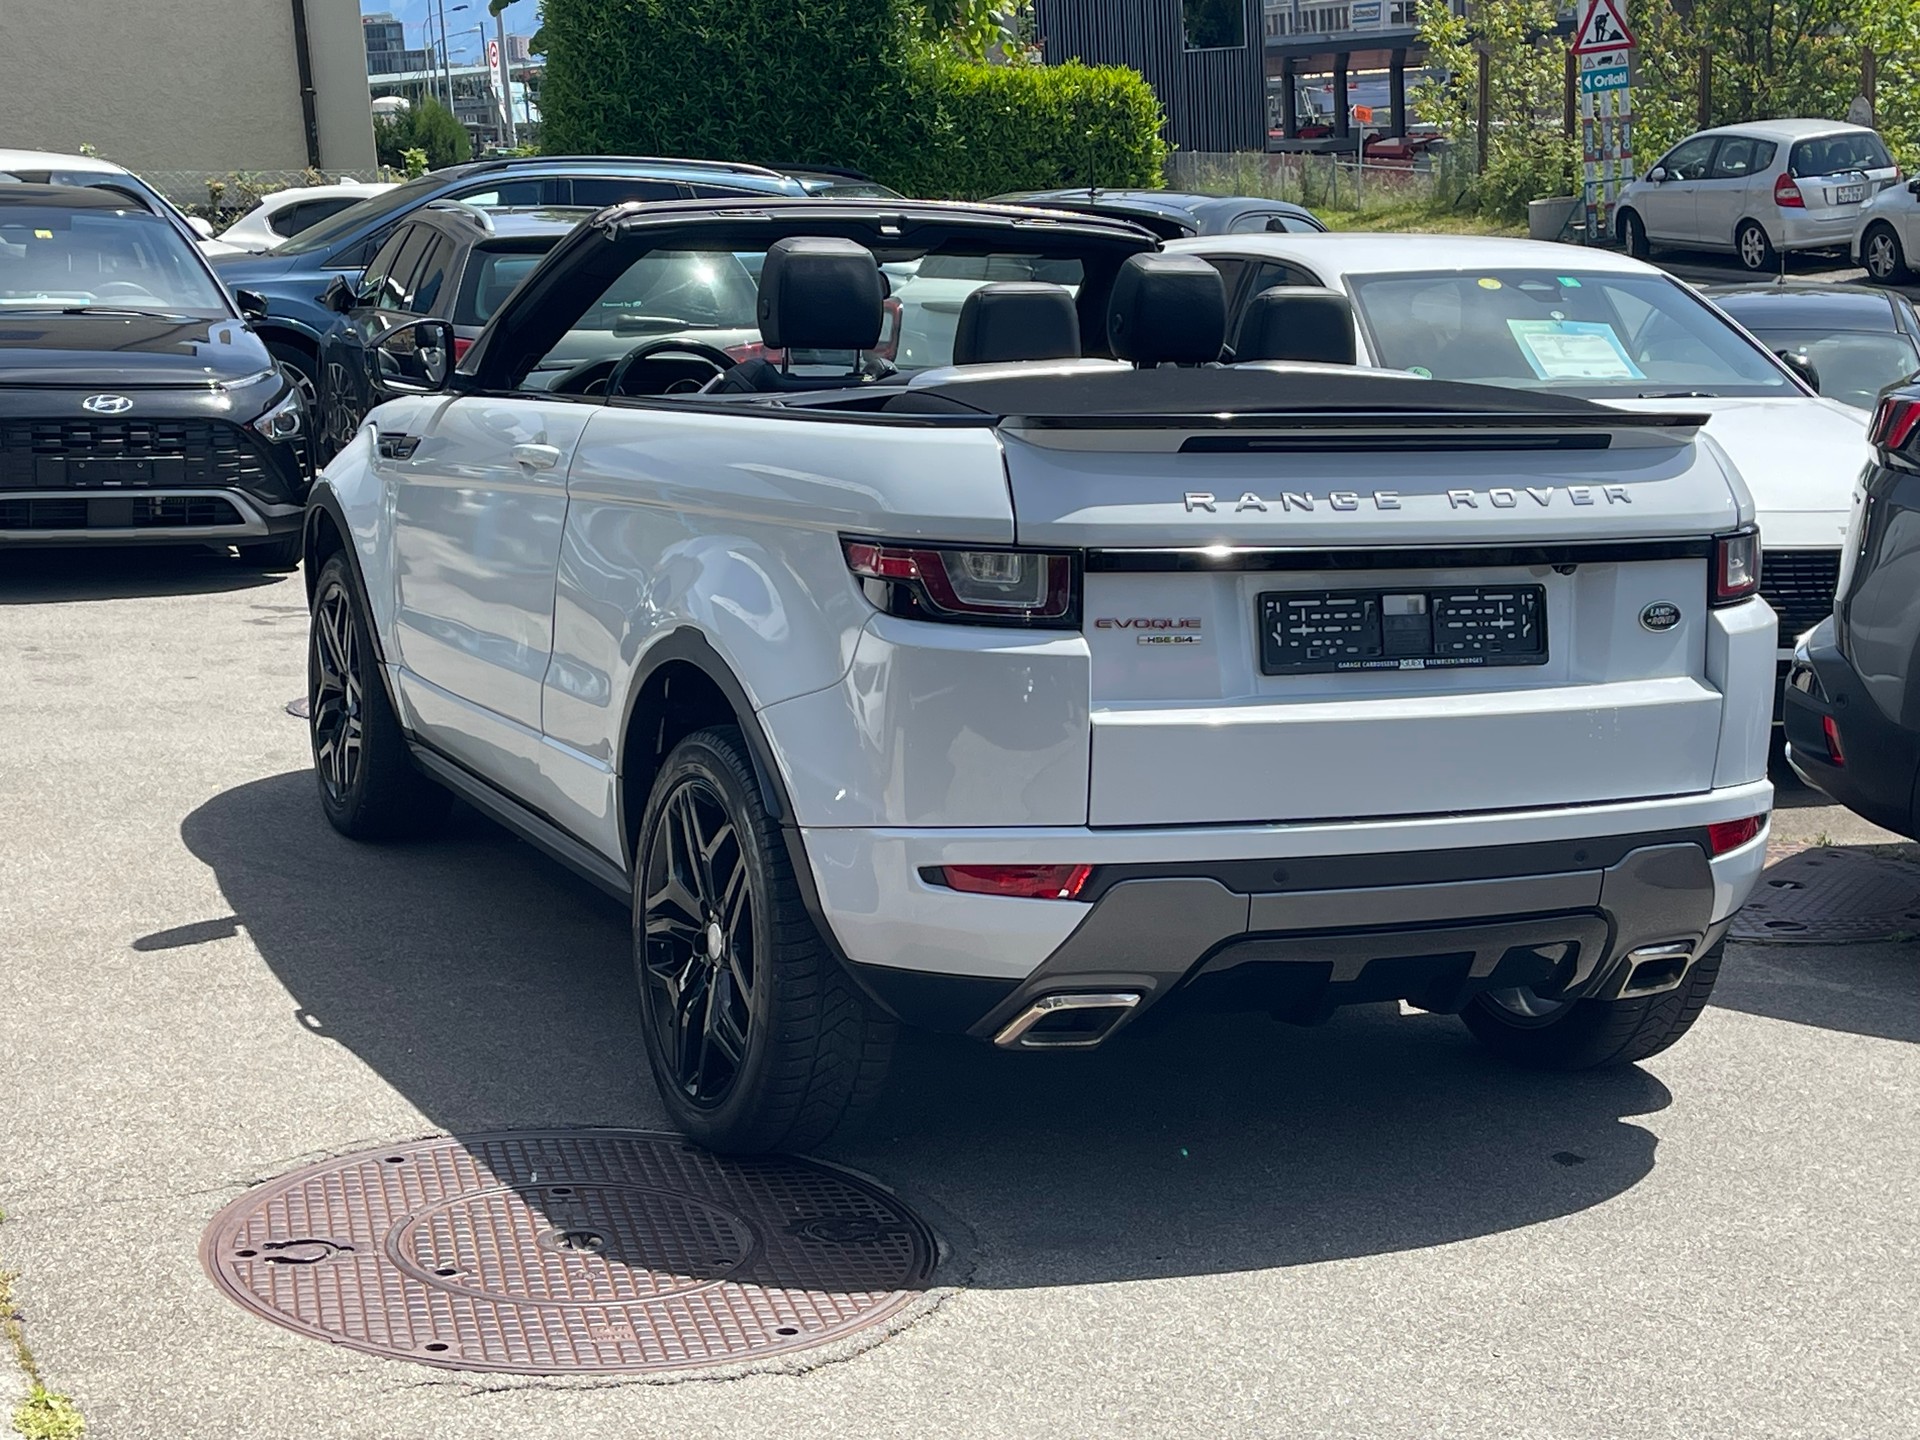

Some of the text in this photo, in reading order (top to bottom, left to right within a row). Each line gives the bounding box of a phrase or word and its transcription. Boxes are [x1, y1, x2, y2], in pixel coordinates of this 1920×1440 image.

[1184, 485, 1632, 512] RANGE ROVER
[1095, 618, 1202, 629] EVOQUE
